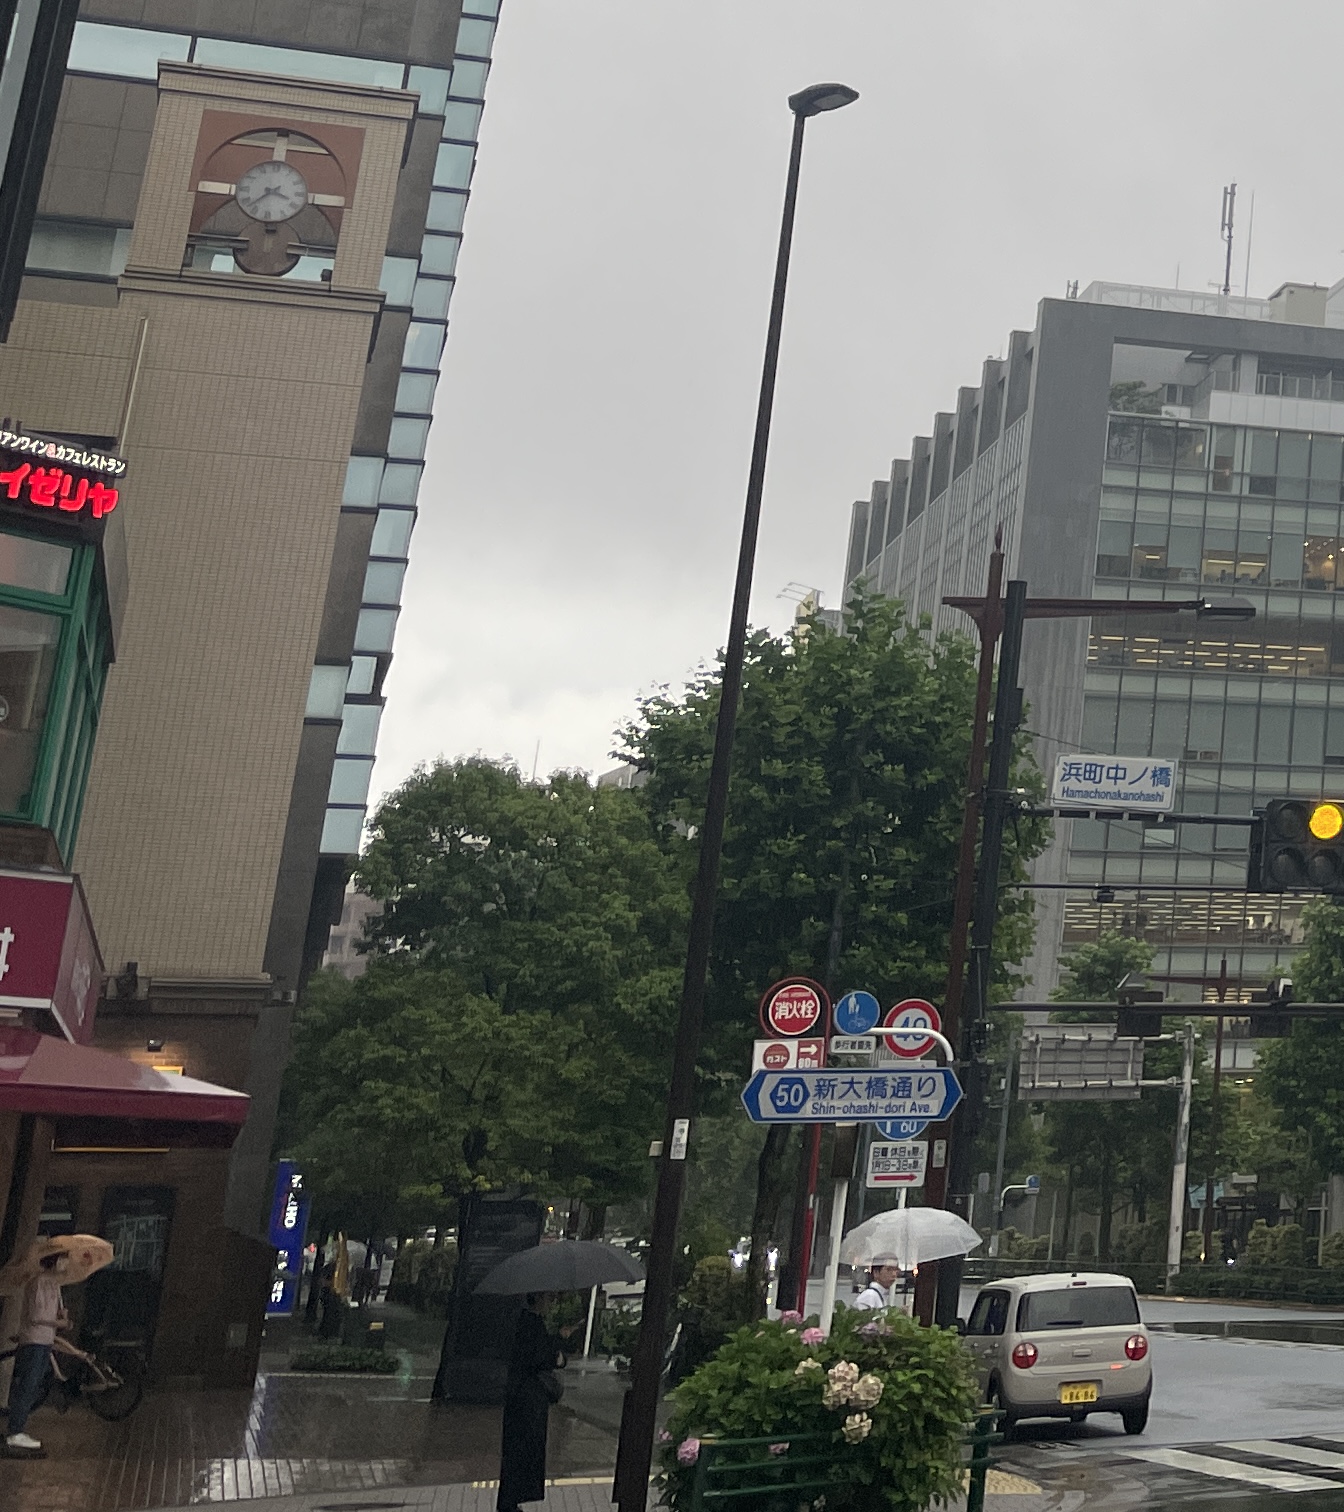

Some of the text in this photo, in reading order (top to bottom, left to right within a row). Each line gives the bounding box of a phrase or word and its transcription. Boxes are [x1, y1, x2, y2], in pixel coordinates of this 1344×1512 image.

[1060, 762, 1172, 787] 浜町中ノ橋
[775, 1000, 816, 1020] 消火栓
[775, 1083, 804, 1107] 50
[813, 1076, 937, 1100] 新大橋通り
[811, 1101, 906, 1115] Shin-ohashi-dori
